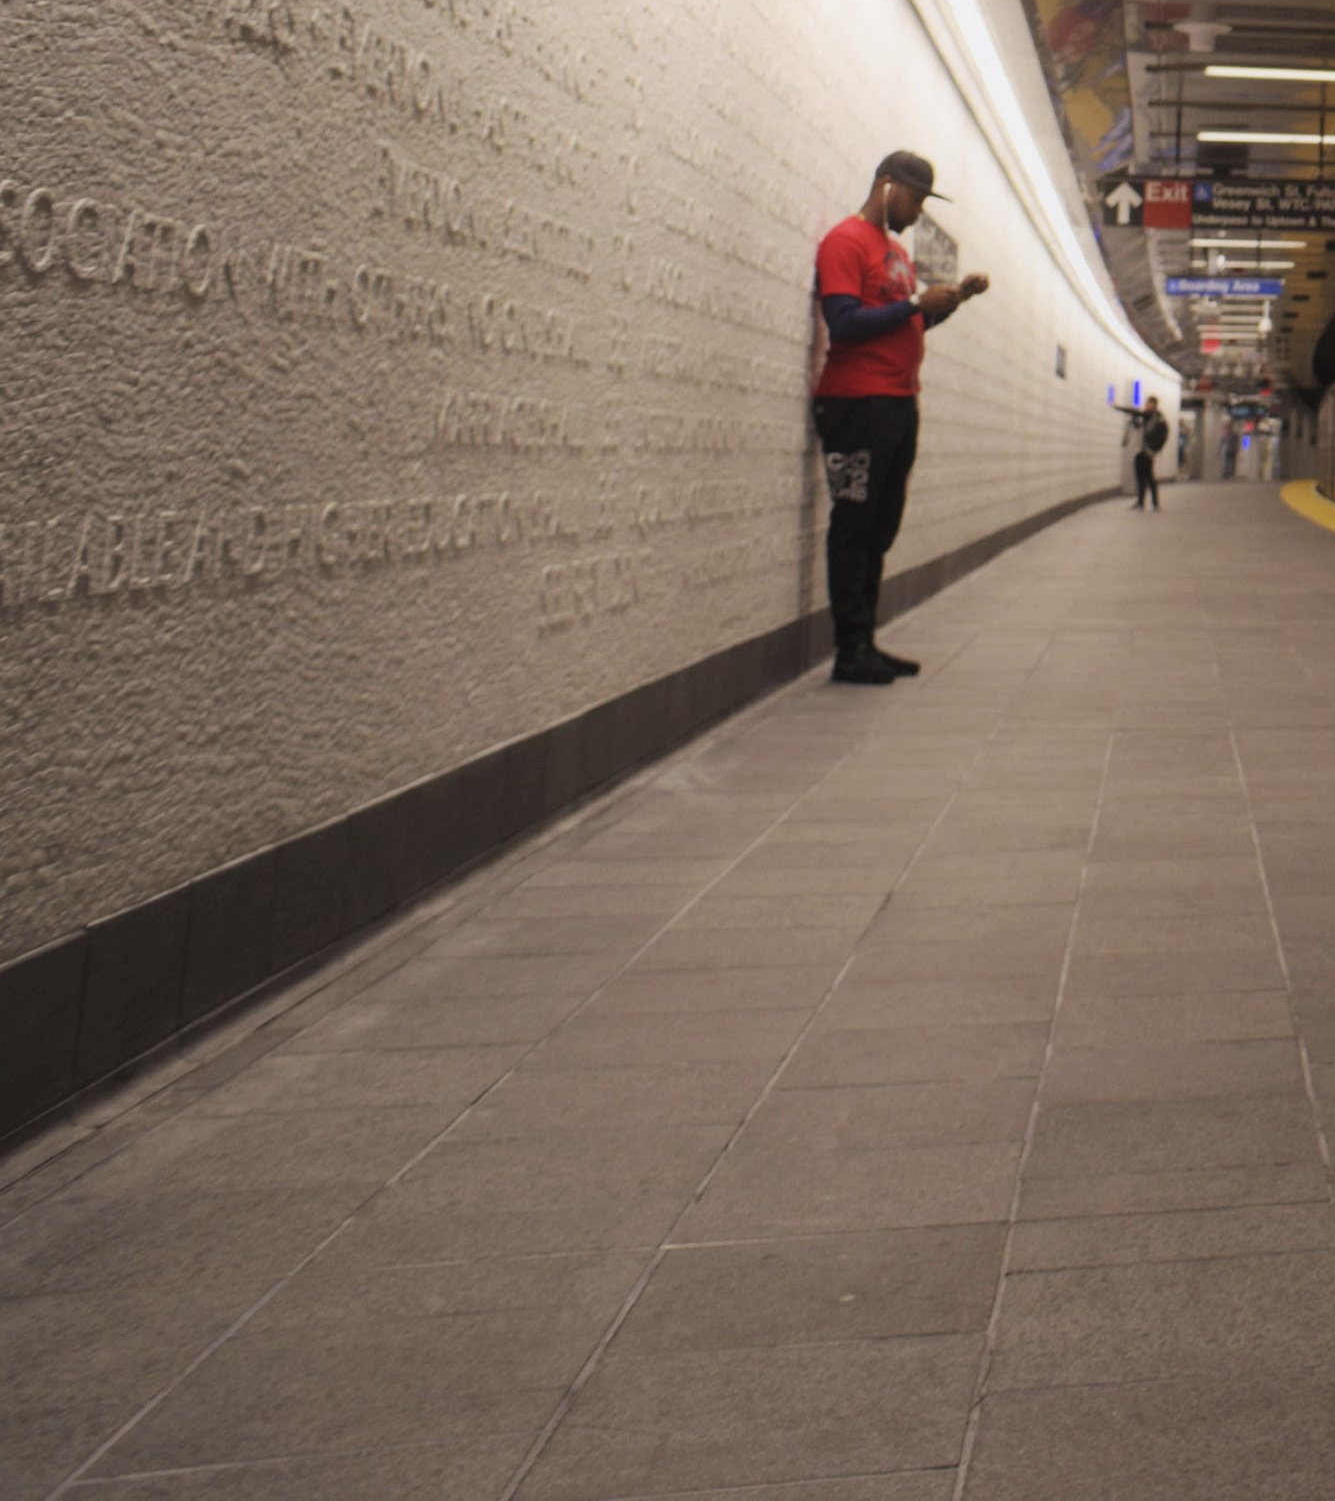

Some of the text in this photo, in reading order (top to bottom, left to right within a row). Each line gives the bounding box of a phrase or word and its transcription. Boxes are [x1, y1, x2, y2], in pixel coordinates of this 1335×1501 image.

[328, 7, 463, 133] EVERYONE
[1146, 181, 1188, 202] Exit
[1213, 183, 1280, 197] Greenwich
[1213, 198, 1250, 212] Vesey
[1265, 216, 1305, 228] Uptown
[1232, 279, 1260, 293] Area
[184, 507, 267, 588] AND
